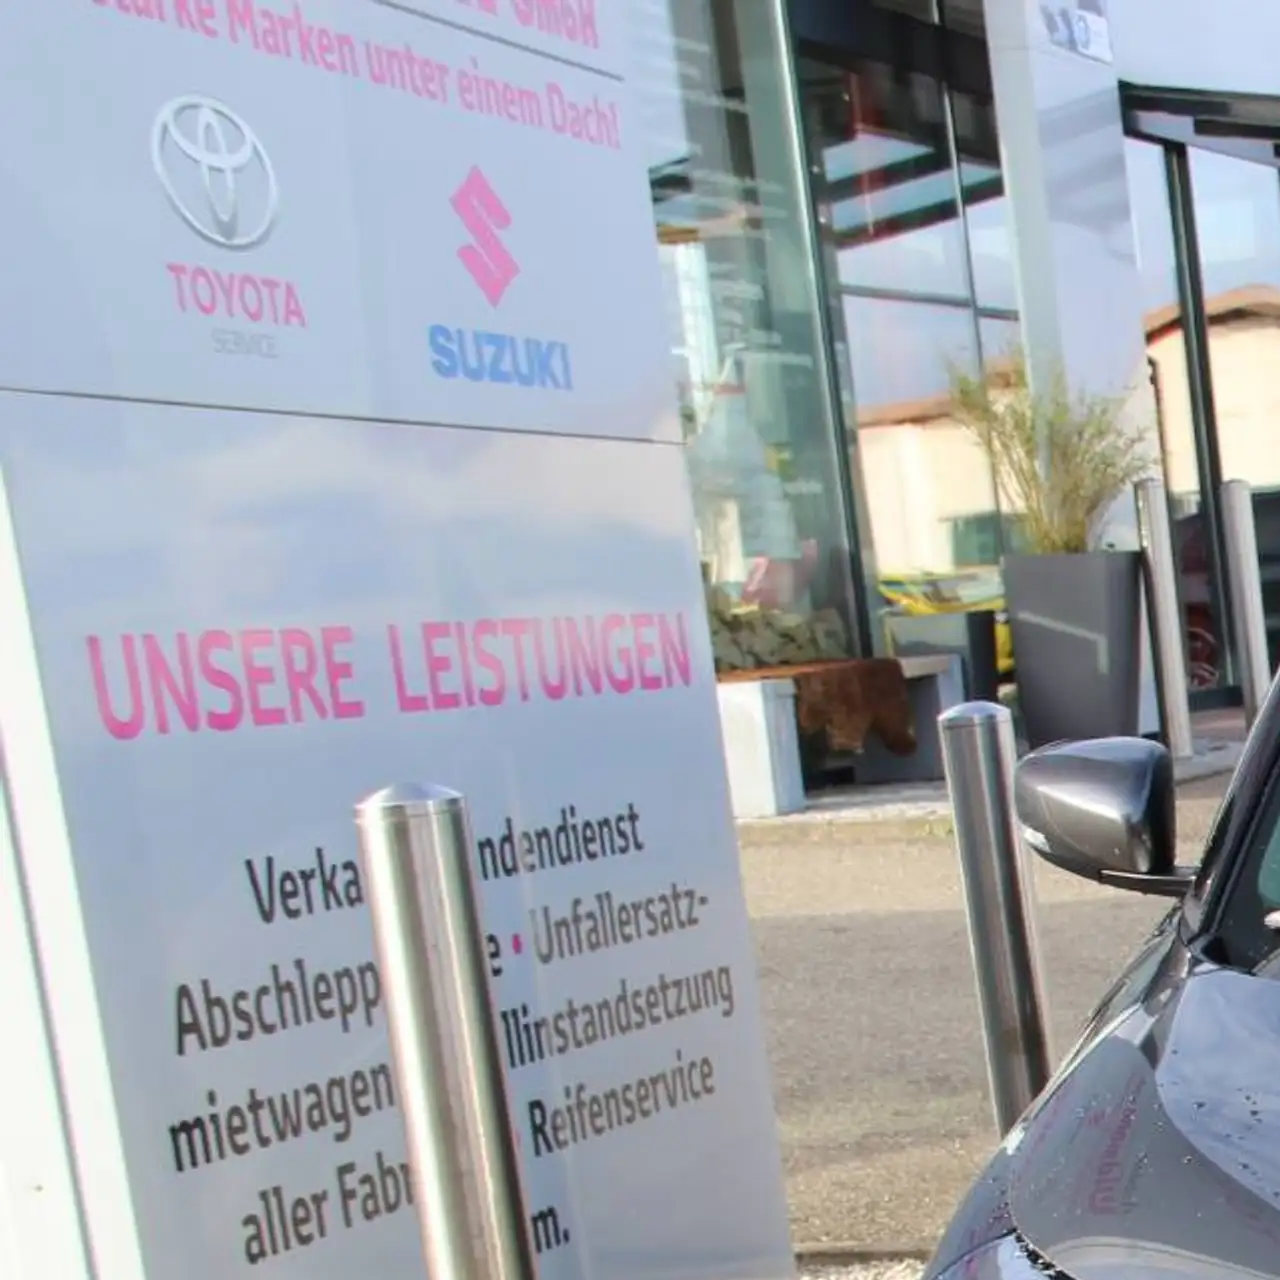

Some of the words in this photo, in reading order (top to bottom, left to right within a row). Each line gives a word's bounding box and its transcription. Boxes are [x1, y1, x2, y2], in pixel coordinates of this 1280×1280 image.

[225, 0, 360, 78] Marken
[366, 40, 450, 104] unter
[457, 55, 544, 129] einem
[546, 82, 622, 150] Dach!
[166, 263, 306, 328] TOYOTA
[429, 324, 574, 391] SUZUKI
[84, 625, 365, 741] UNSERE
[386, 612, 692, 713] LEISTUNGEN
[245, 846, 364, 924] Verka
[477, 802, 645, 881] ndendienst
[528, 882, 709, 965] Unfallersatz-
[168, 1062, 395, 1173] mietwagen
[500, 965, 734, 1069] llinstandsetzung
[241, 1185, 328, 1265] aller
[528, 1049, 716, 1158] Reifenservice
